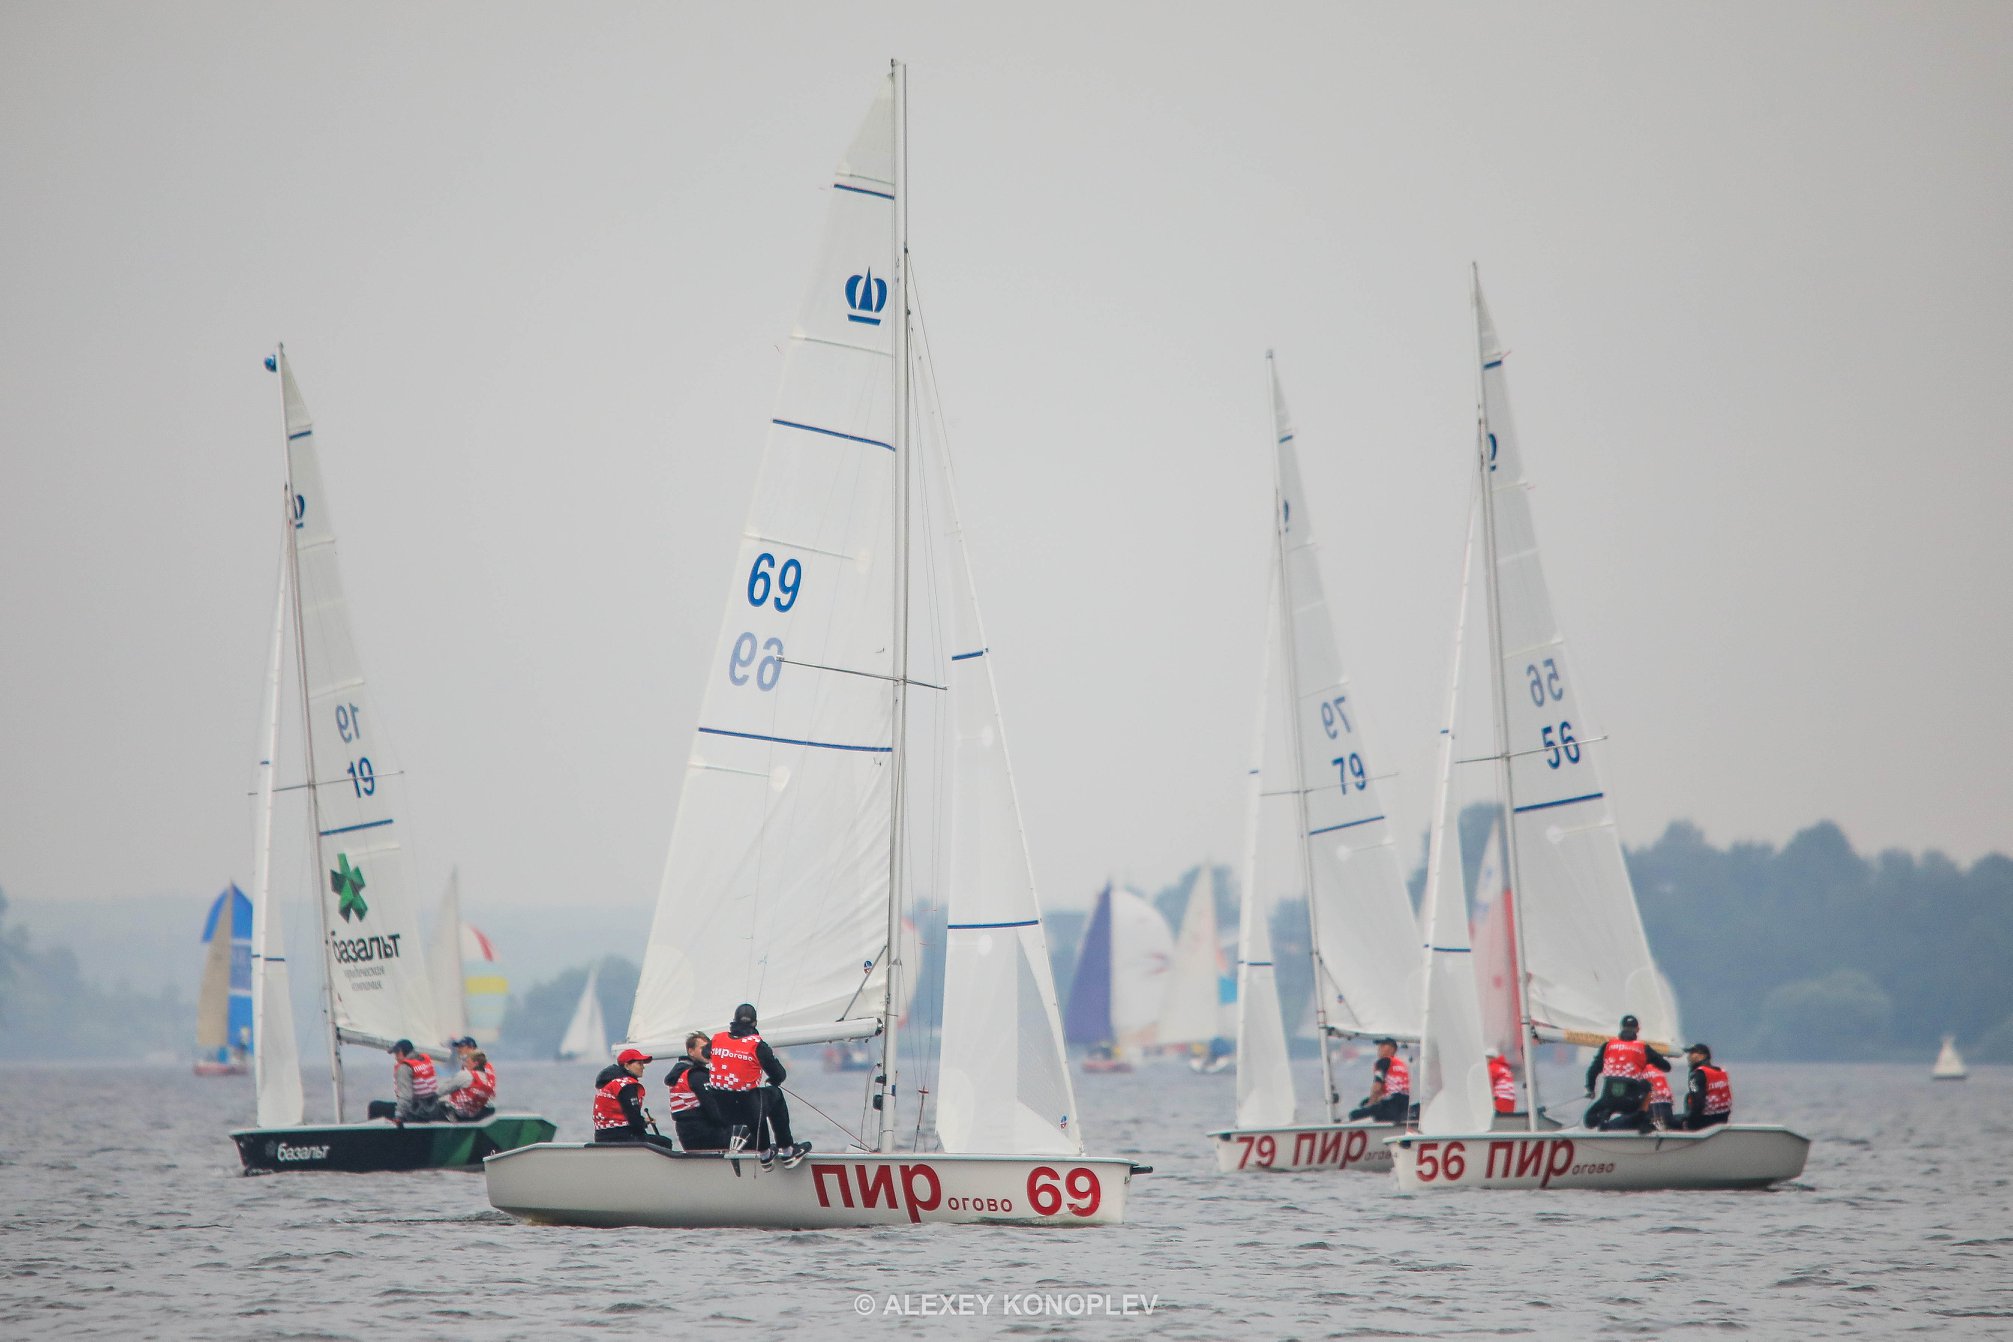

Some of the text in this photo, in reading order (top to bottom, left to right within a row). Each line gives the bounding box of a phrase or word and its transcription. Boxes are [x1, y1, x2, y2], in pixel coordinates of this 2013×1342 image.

[747, 553, 802, 613] 69
[1541, 721, 1580, 769] 56
[347, 757, 375, 798] 19
[1332, 752, 1366, 795] 79
[277, 1143, 331, 1161] базальт
[1237, 1136, 1276, 1170] 79
[1416, 1141, 1465, 1182] 56
[1026, 1166, 1101, 1217] 69
